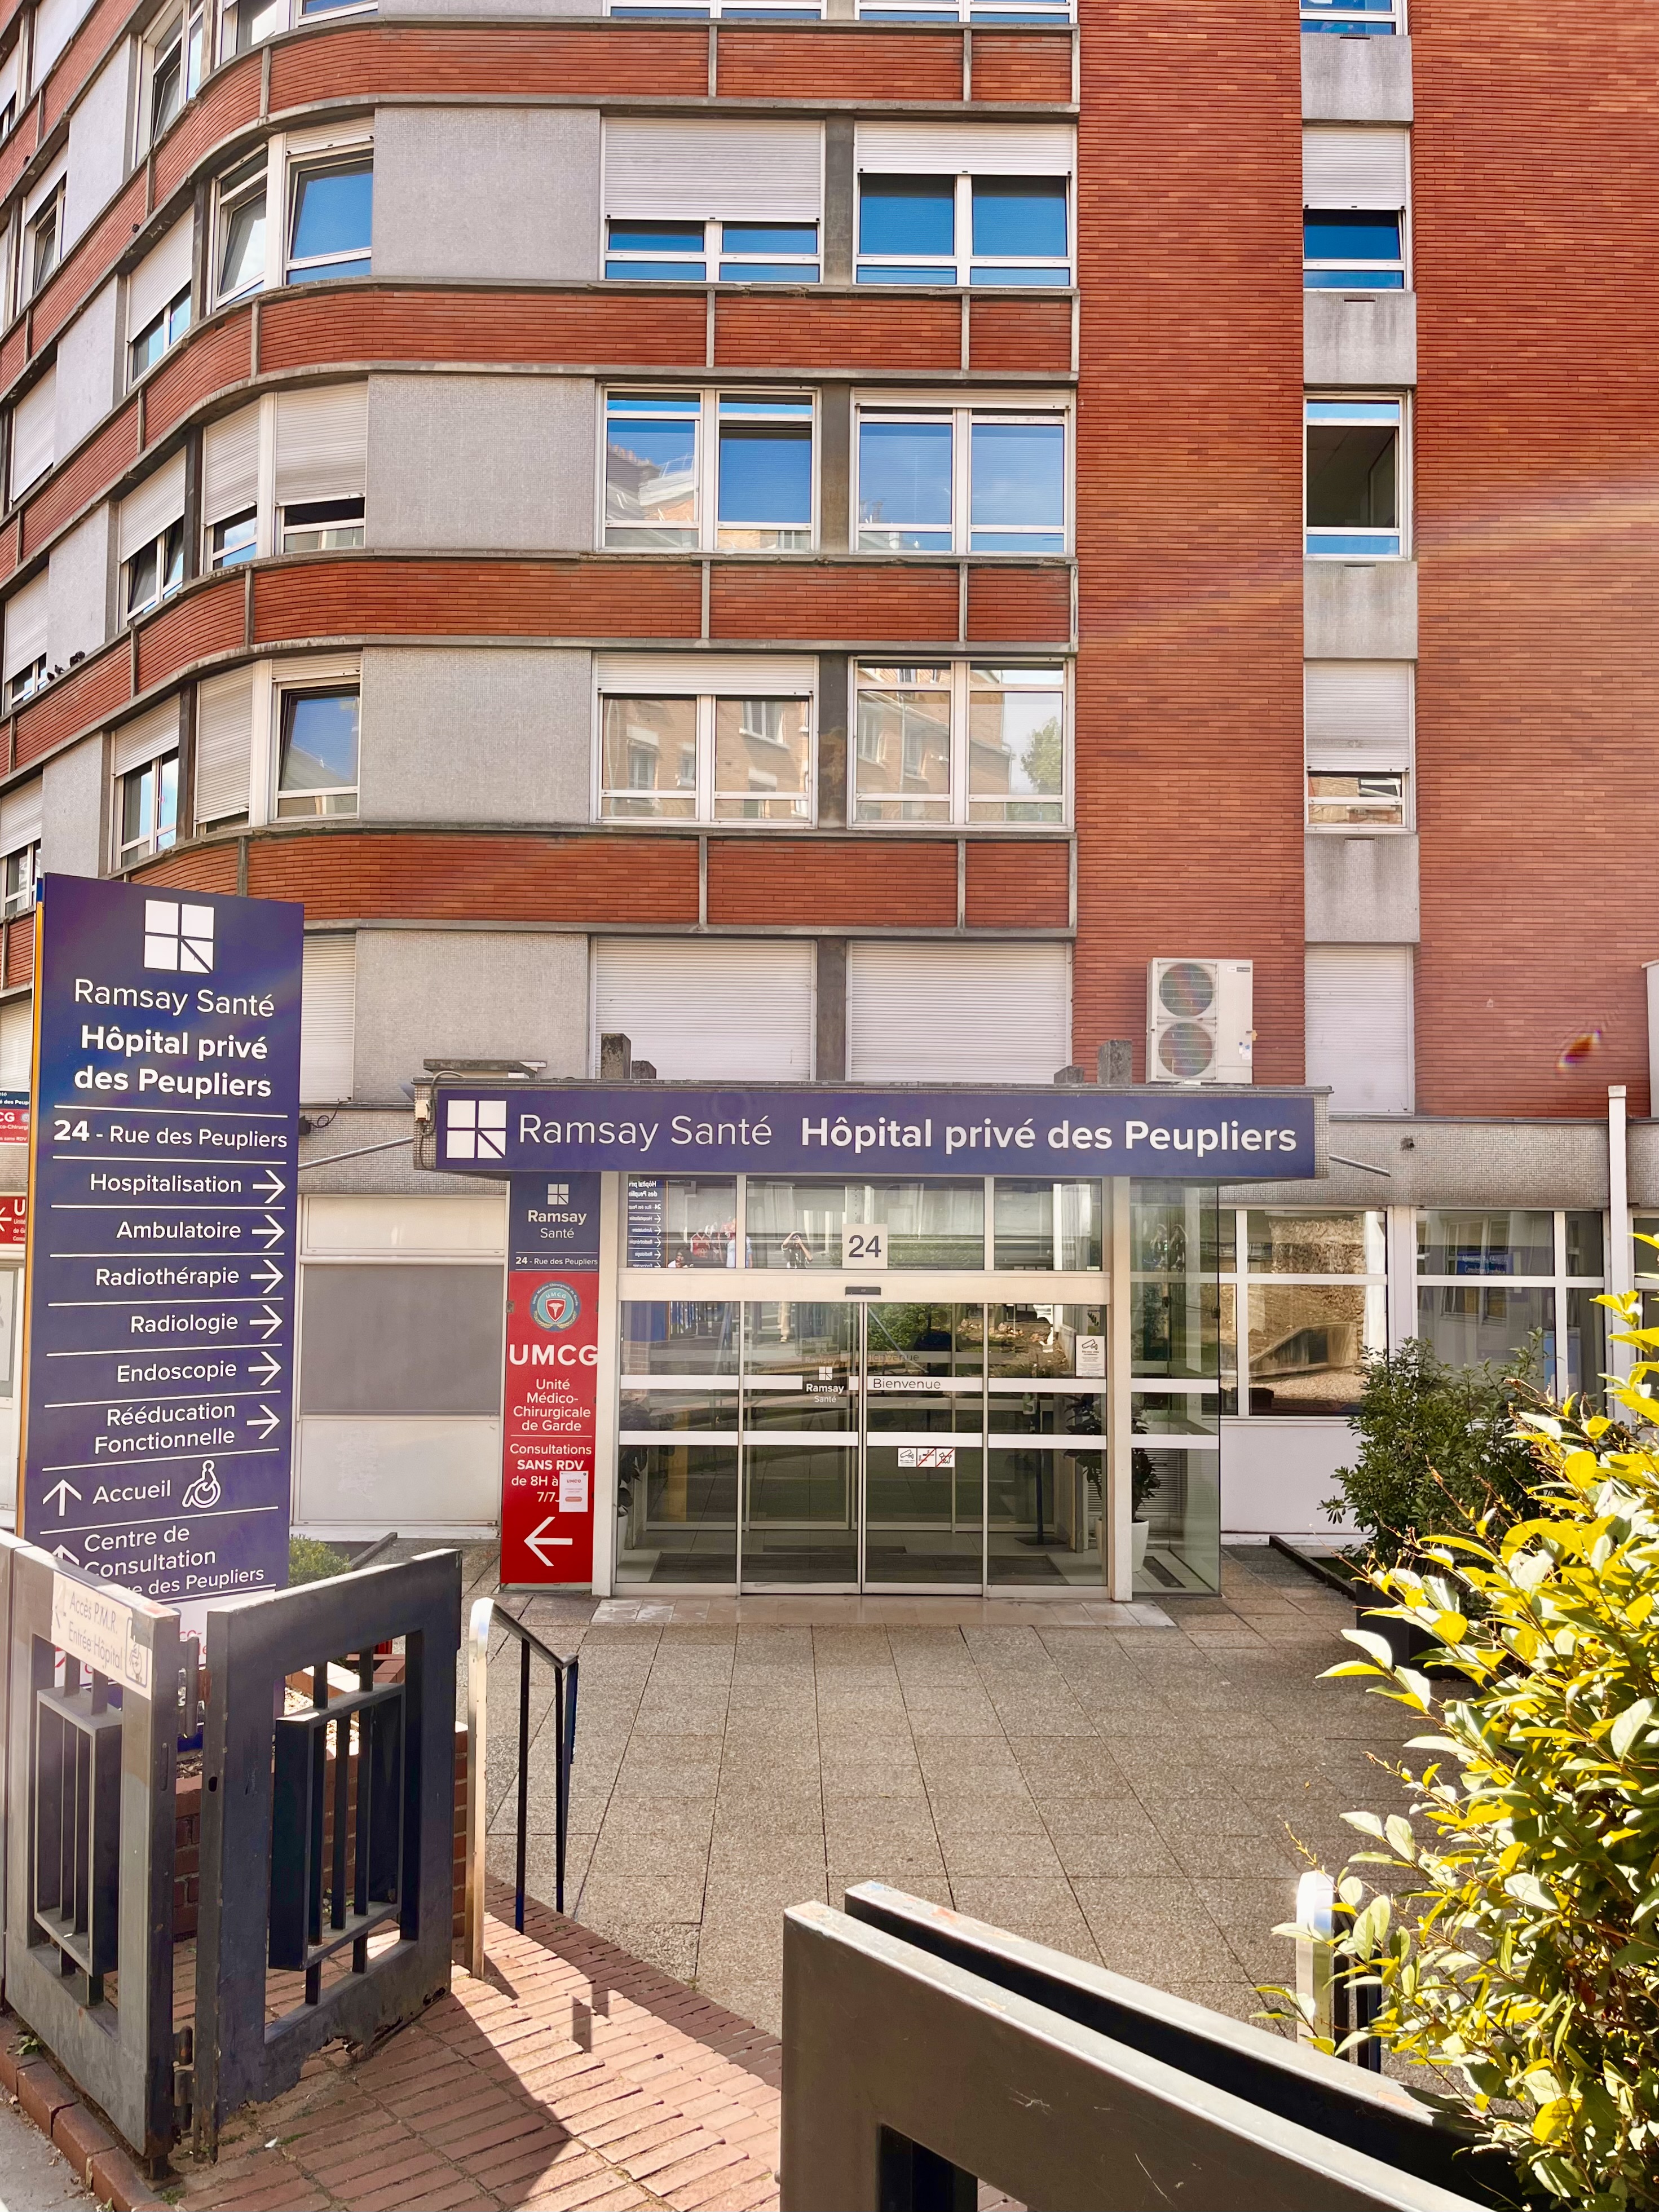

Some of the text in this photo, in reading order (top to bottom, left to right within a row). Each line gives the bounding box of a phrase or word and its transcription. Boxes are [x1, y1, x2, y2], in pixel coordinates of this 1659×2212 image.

[74, 978, 275, 1017] Ramsay Santé
[81, 1025, 268, 1061] Hôpital privé
[74, 1066, 272, 1100] des Peupliers
[54, 1120, 90, 1141] 24
[111, 1126, 149, 1143] Rue
[156, 1127, 192, 1145] des
[199, 1127, 288, 1151] Peupliers
[519, 1114, 1297, 1158] Ramsay Santé Hôpital privé des Peupliers
[90, 1173, 242, 1196] Hospitalisation
[116, 1221, 241, 1238] Ambulatoire
[527, 1209, 587, 1227] Ramsay
[540, 1226, 575, 1239] Santé
[849, 1234, 882, 1258] 24
[96, 1267, 239, 1288] Radiothérapie
[130, 1314, 239, 1339] Radiologie
[510, 1344, 598, 1366] UMCG
[117, 1361, 237, 1385] Endoscopie
[536, 1379, 570, 1390] Unité
[873, 1378, 941, 1389] Bienvenue
[527, 1392, 579, 1403] Médico-
[806, 1384, 844, 1394] Ramsay
[107, 1403, 235, 1427] Rééducation
[513, 1406, 591, 1420] Chirurgicale
[522, 1420, 581, 1431] de Garde
[94, 1428, 235, 1455] Fonctionnelle
[510, 1443, 592, 1455] Consultations
[517, 1459, 584, 1471] SANS RDV
[92, 1480, 170, 1504] Accueil
[511, 1476, 558, 1486] de 8H à
[84, 1526, 189, 1553] Centre de
[85, 1551, 215, 1578] Consultation
[148, 1579, 179, 1595] des
[186, 1569, 264, 1589] Peupliers
[70, 1592, 118, 1634] Accès P.M.R.
[69, 1621, 122, 1671] Entrée Hôpital
